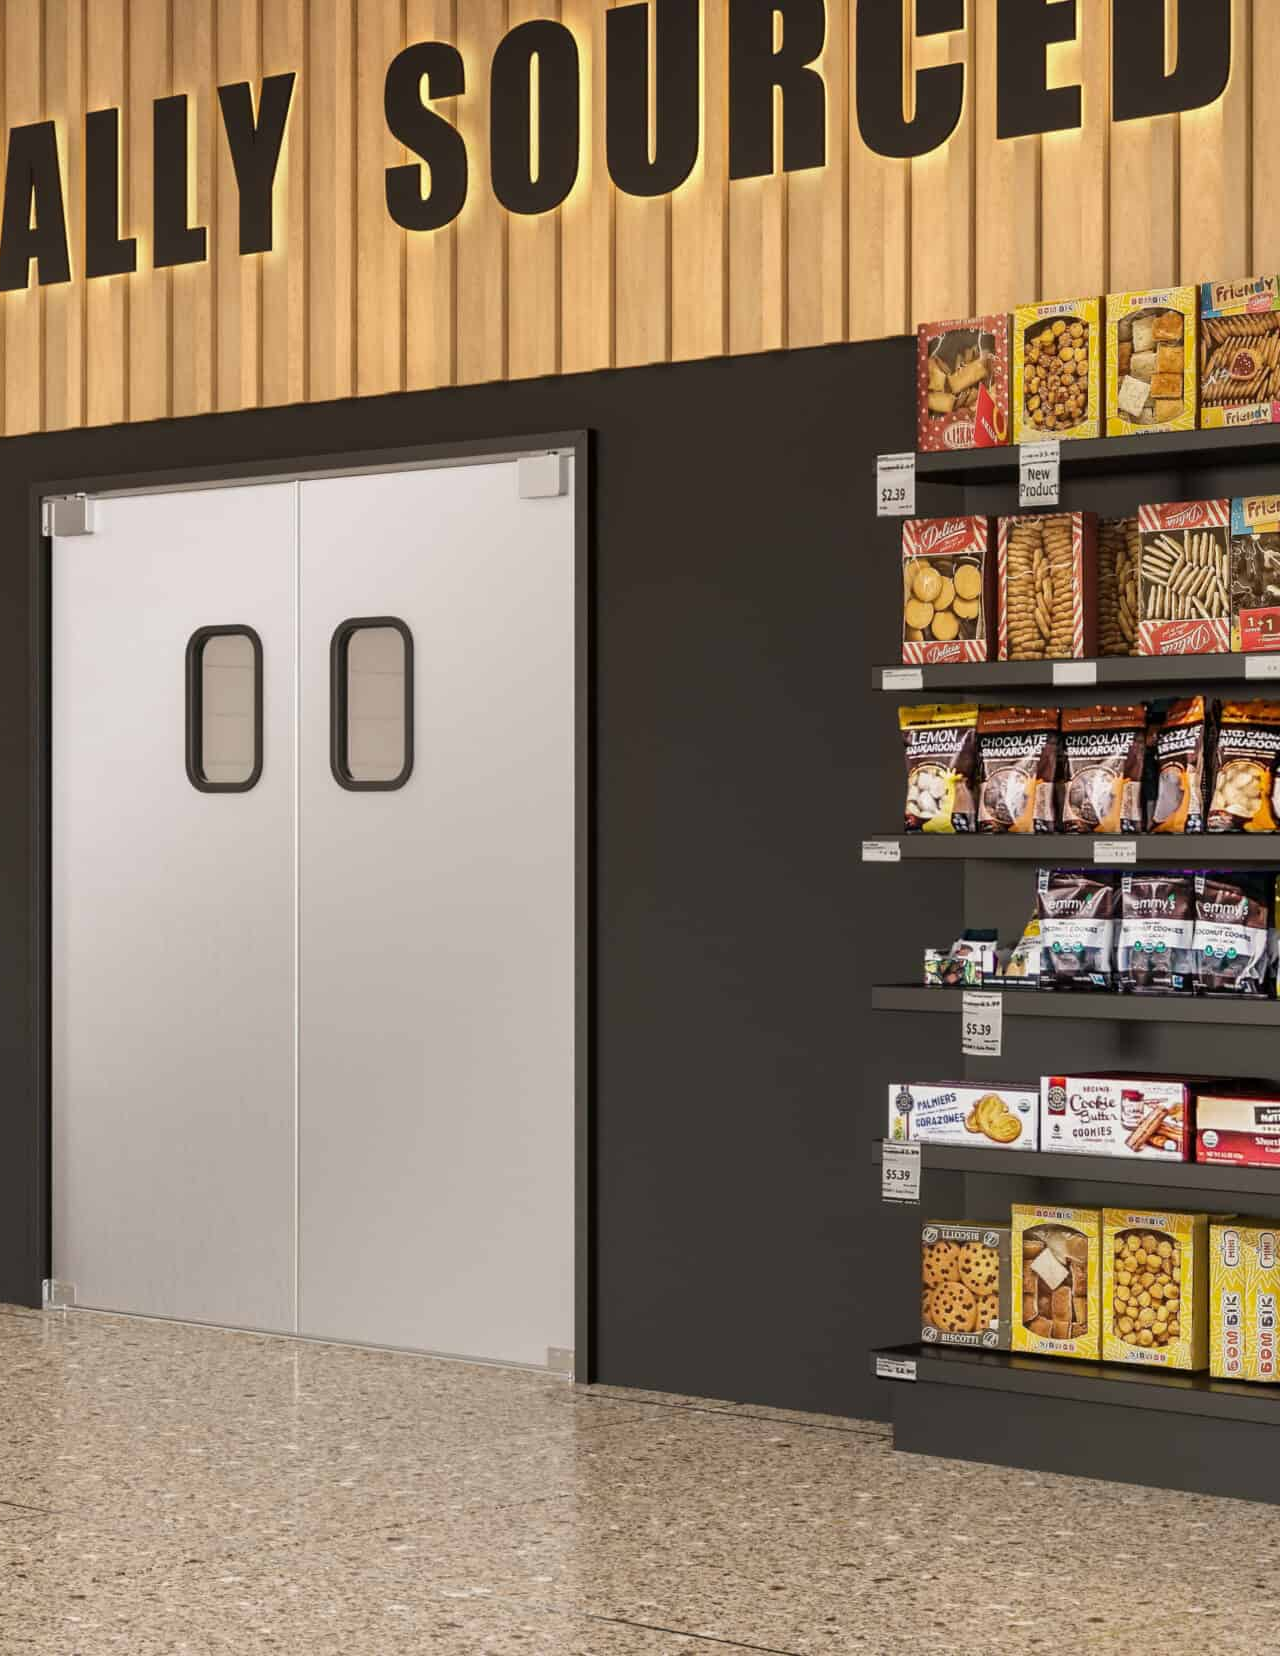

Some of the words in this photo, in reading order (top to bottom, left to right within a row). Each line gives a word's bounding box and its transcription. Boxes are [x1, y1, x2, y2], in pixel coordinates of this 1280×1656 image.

[384, 0, 1233, 232] SOURCED
[1027, 468, 1050, 481] New
[881, 487, 906, 502] $2.39
[1020, 483, 1060, 497] Product
[921, 520, 967, 549] Delicia
[911, 730, 959, 746] LEMON
[981, 734, 1048, 748] CHOCOLATE
[1065, 732, 1135, 746] CHOCOLATE
[966, 1022, 992, 1036] $5.39
[916, 1092, 957, 1111] PALMIERS
[1070, 1094, 1116, 1115] Cookie
[915, 1112, 966, 1128] CORAZONES
[1072, 1126, 1112, 1137] COOKIES
[886, 1168, 911, 1181] $5.39
